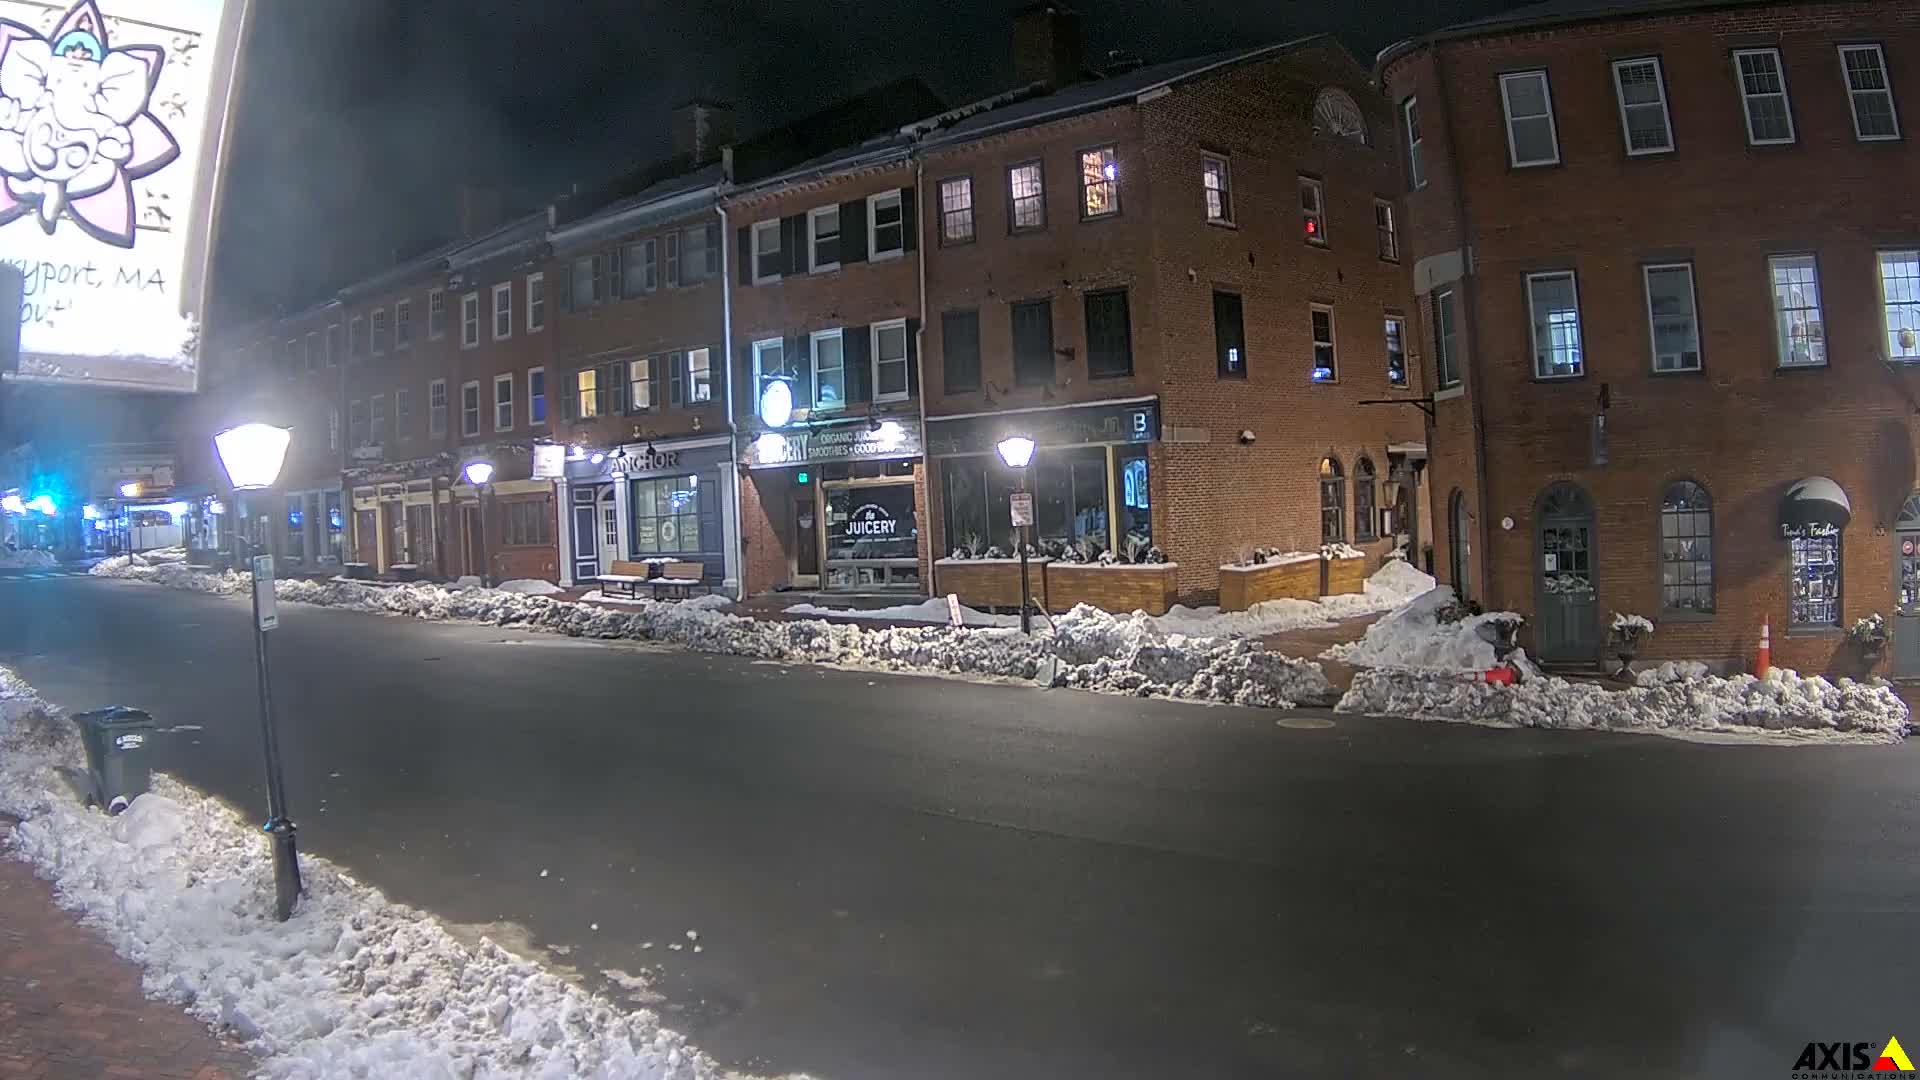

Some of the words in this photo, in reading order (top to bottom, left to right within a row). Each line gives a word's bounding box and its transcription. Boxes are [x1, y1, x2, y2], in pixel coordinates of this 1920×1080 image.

[115, 266, 165, 294] MA
[1133, 412, 1147, 432] B
[820, 431, 853, 445] ORGANIC
[808, 445, 849, 459] SMOOTHIES
[854, 442, 877, 455] GOOD
[611, 451, 680, 473] ANCHOR
[845, 519, 897, 535] JUICERY
